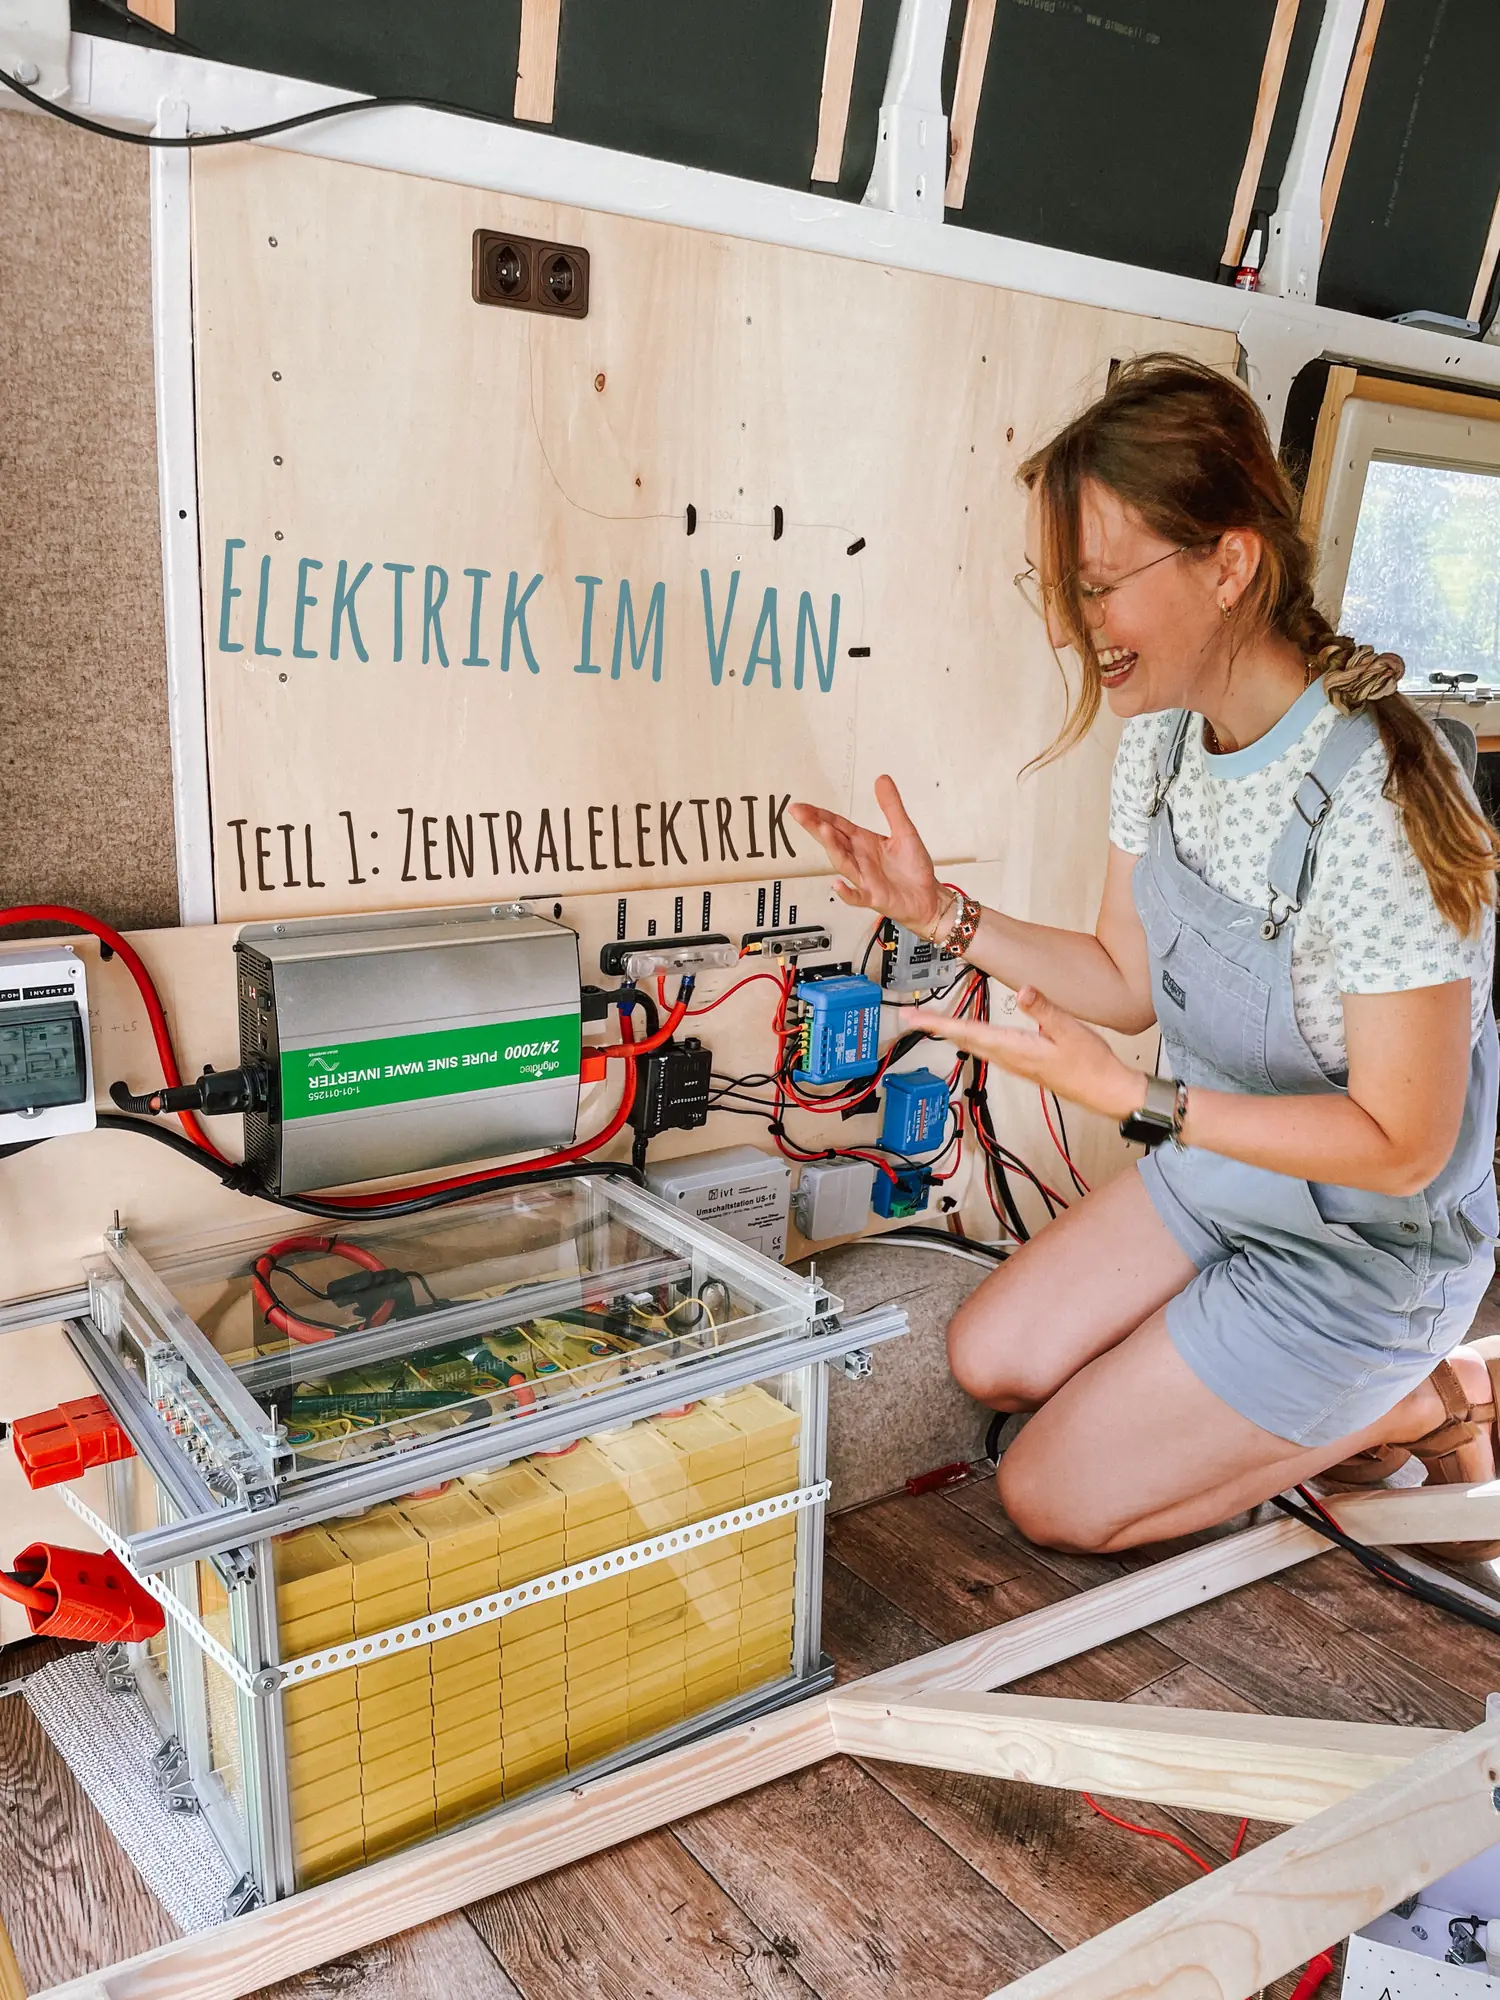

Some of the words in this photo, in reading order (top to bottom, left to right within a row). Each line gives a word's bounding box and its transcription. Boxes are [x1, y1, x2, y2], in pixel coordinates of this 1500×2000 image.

[29, 986, 74, 997] INVERTER
[462, 1050, 498, 1067] PURE
[504, 1040, 560, 1061] 24/2000
[384, 1061, 424, 1078] WAVE
[427, 1056, 459, 1071] SINE
[519, 1061, 560, 1076] offgridtec
[308, 1068, 381, 1090] INVERTER
[308, 1086, 361, 1102] 1-01-011255
[720, 1187, 734, 1199] ivt
[696, 1198, 754, 1217] Umschaltstation
